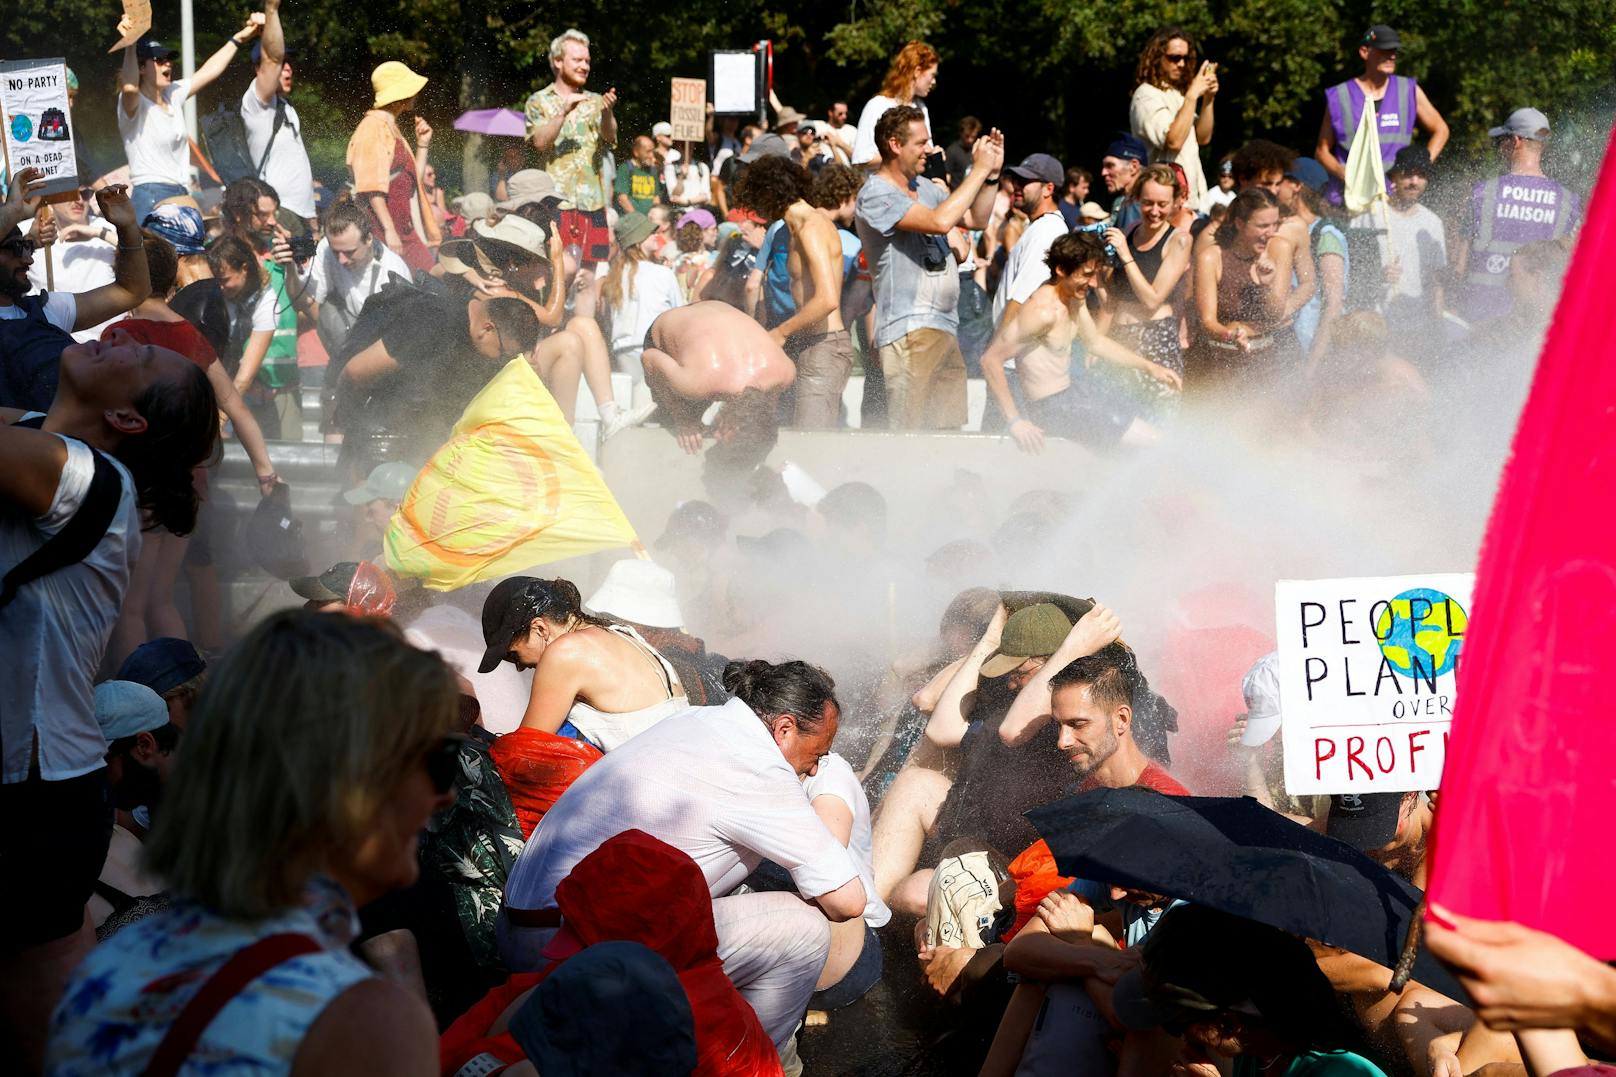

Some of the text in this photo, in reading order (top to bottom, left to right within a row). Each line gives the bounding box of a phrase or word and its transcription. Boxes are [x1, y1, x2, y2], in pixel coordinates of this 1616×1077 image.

[9, 75, 58, 91] NO PARTY
[671, 82, 705, 104] STOP
[672, 105, 704, 122] FOSSIL
[674, 124, 705, 139] FUEL
[20, 152, 63, 166] ON A DEAD
[1502, 185, 1557, 205] POLITIE
[1496, 203, 1556, 225] LIAISON
[1300, 598, 1465, 648] PEOPL
[1305, 654, 1462, 701] PLAN
[1392, 695, 1453, 719] OVER
